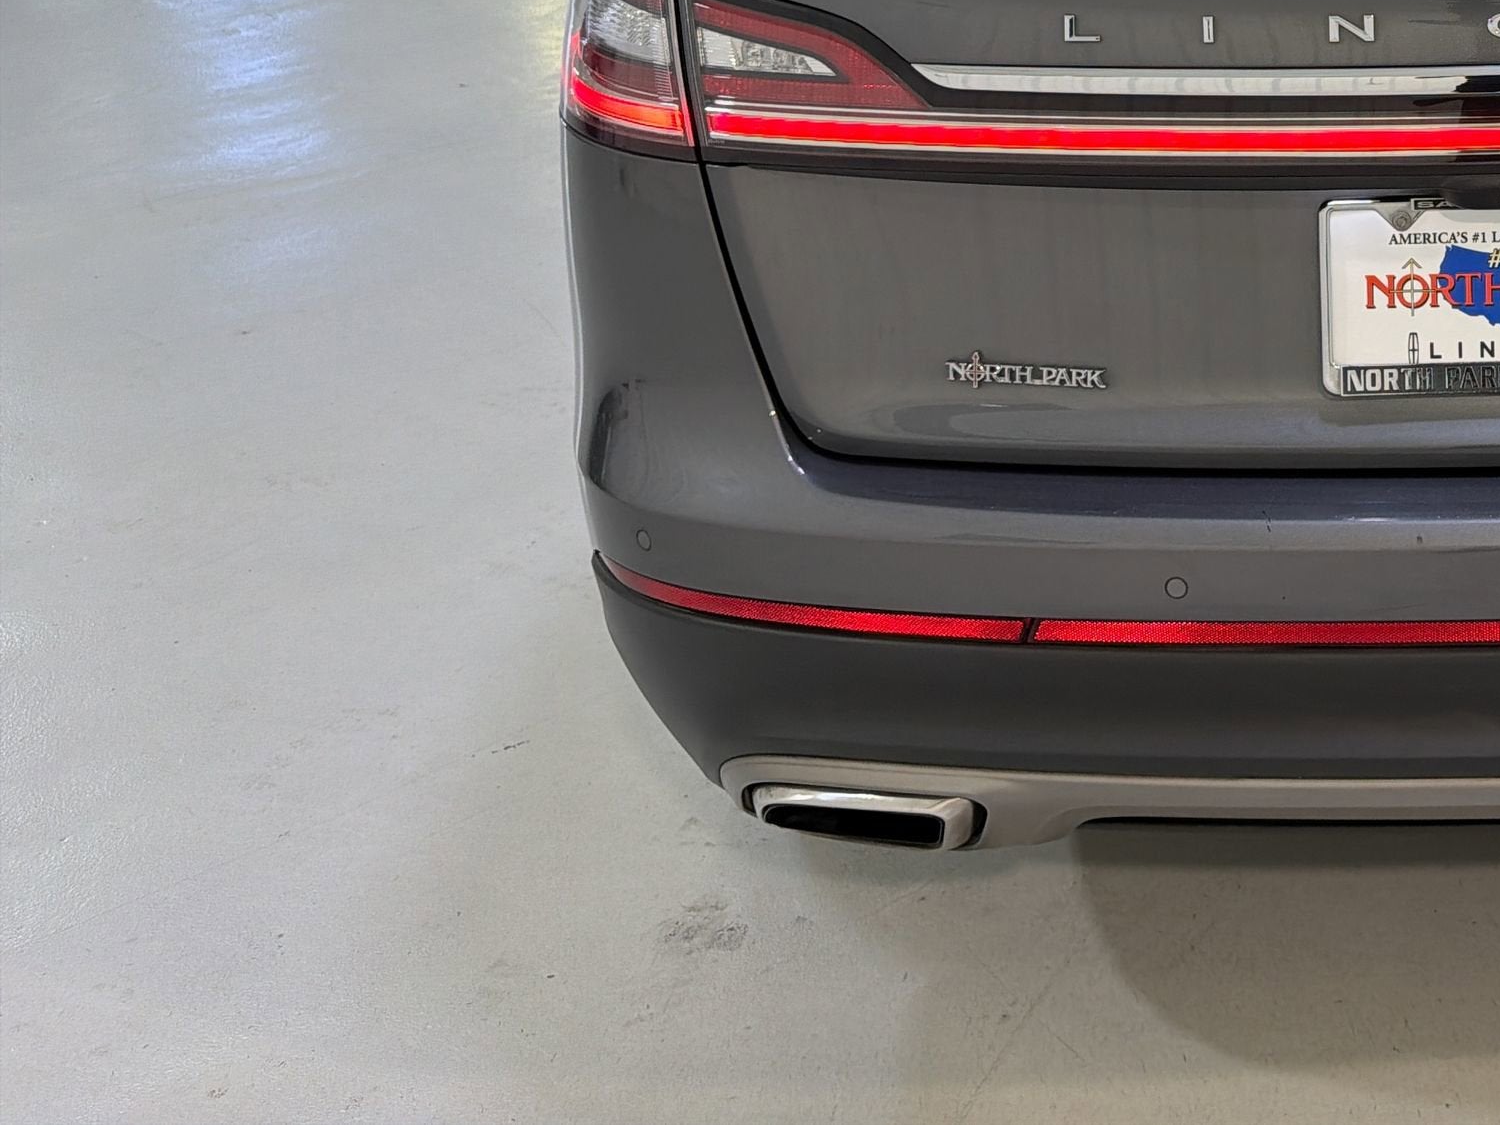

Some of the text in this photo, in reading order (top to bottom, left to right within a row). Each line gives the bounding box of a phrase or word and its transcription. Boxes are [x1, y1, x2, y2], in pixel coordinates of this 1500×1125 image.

[1388, 231, 1469, 246] AMERICA'S
[1471, 231, 1488, 245] #1
[945, 360, 1107, 389] NORTH PARK
[1346, 366, 1434, 392] NORTH
